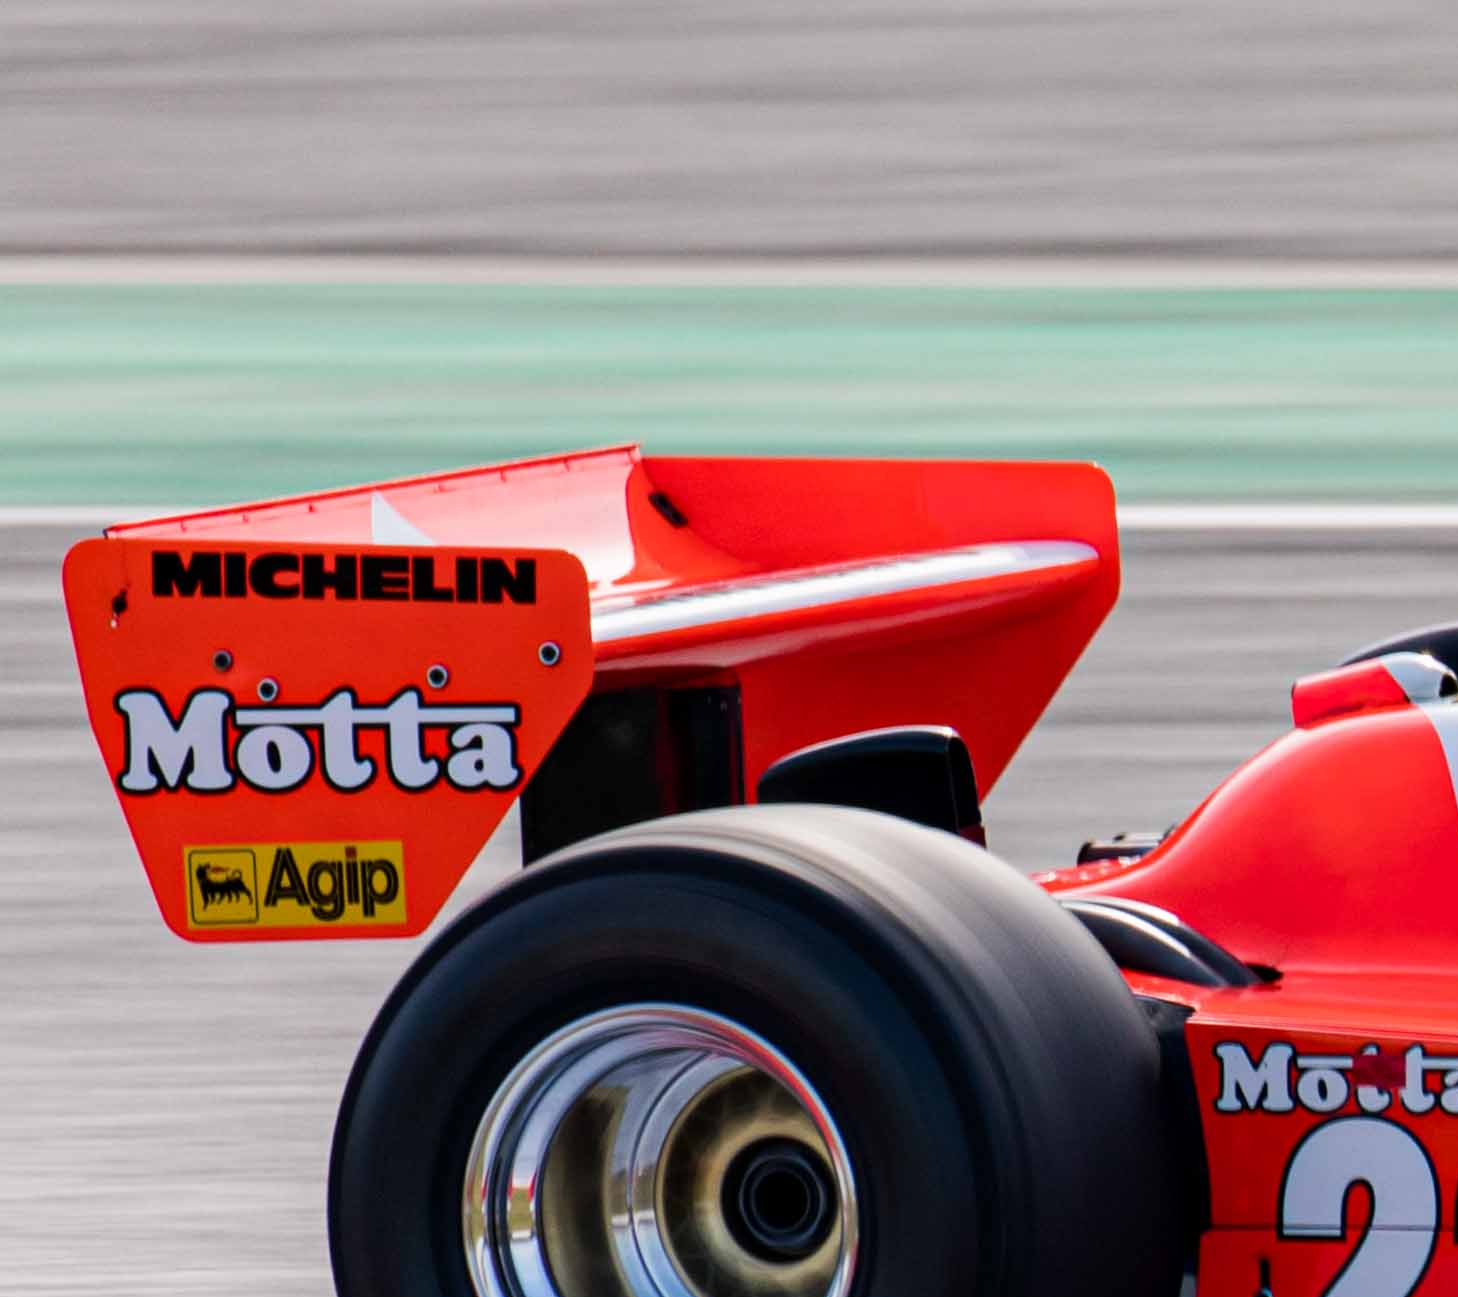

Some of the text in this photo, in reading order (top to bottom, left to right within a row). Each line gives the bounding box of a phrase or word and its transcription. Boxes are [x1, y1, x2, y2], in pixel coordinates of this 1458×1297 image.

[151, 551, 537, 605] MICHELIN
[116, 687, 522, 794] Motta
[264, 847, 399, 918] Agip
